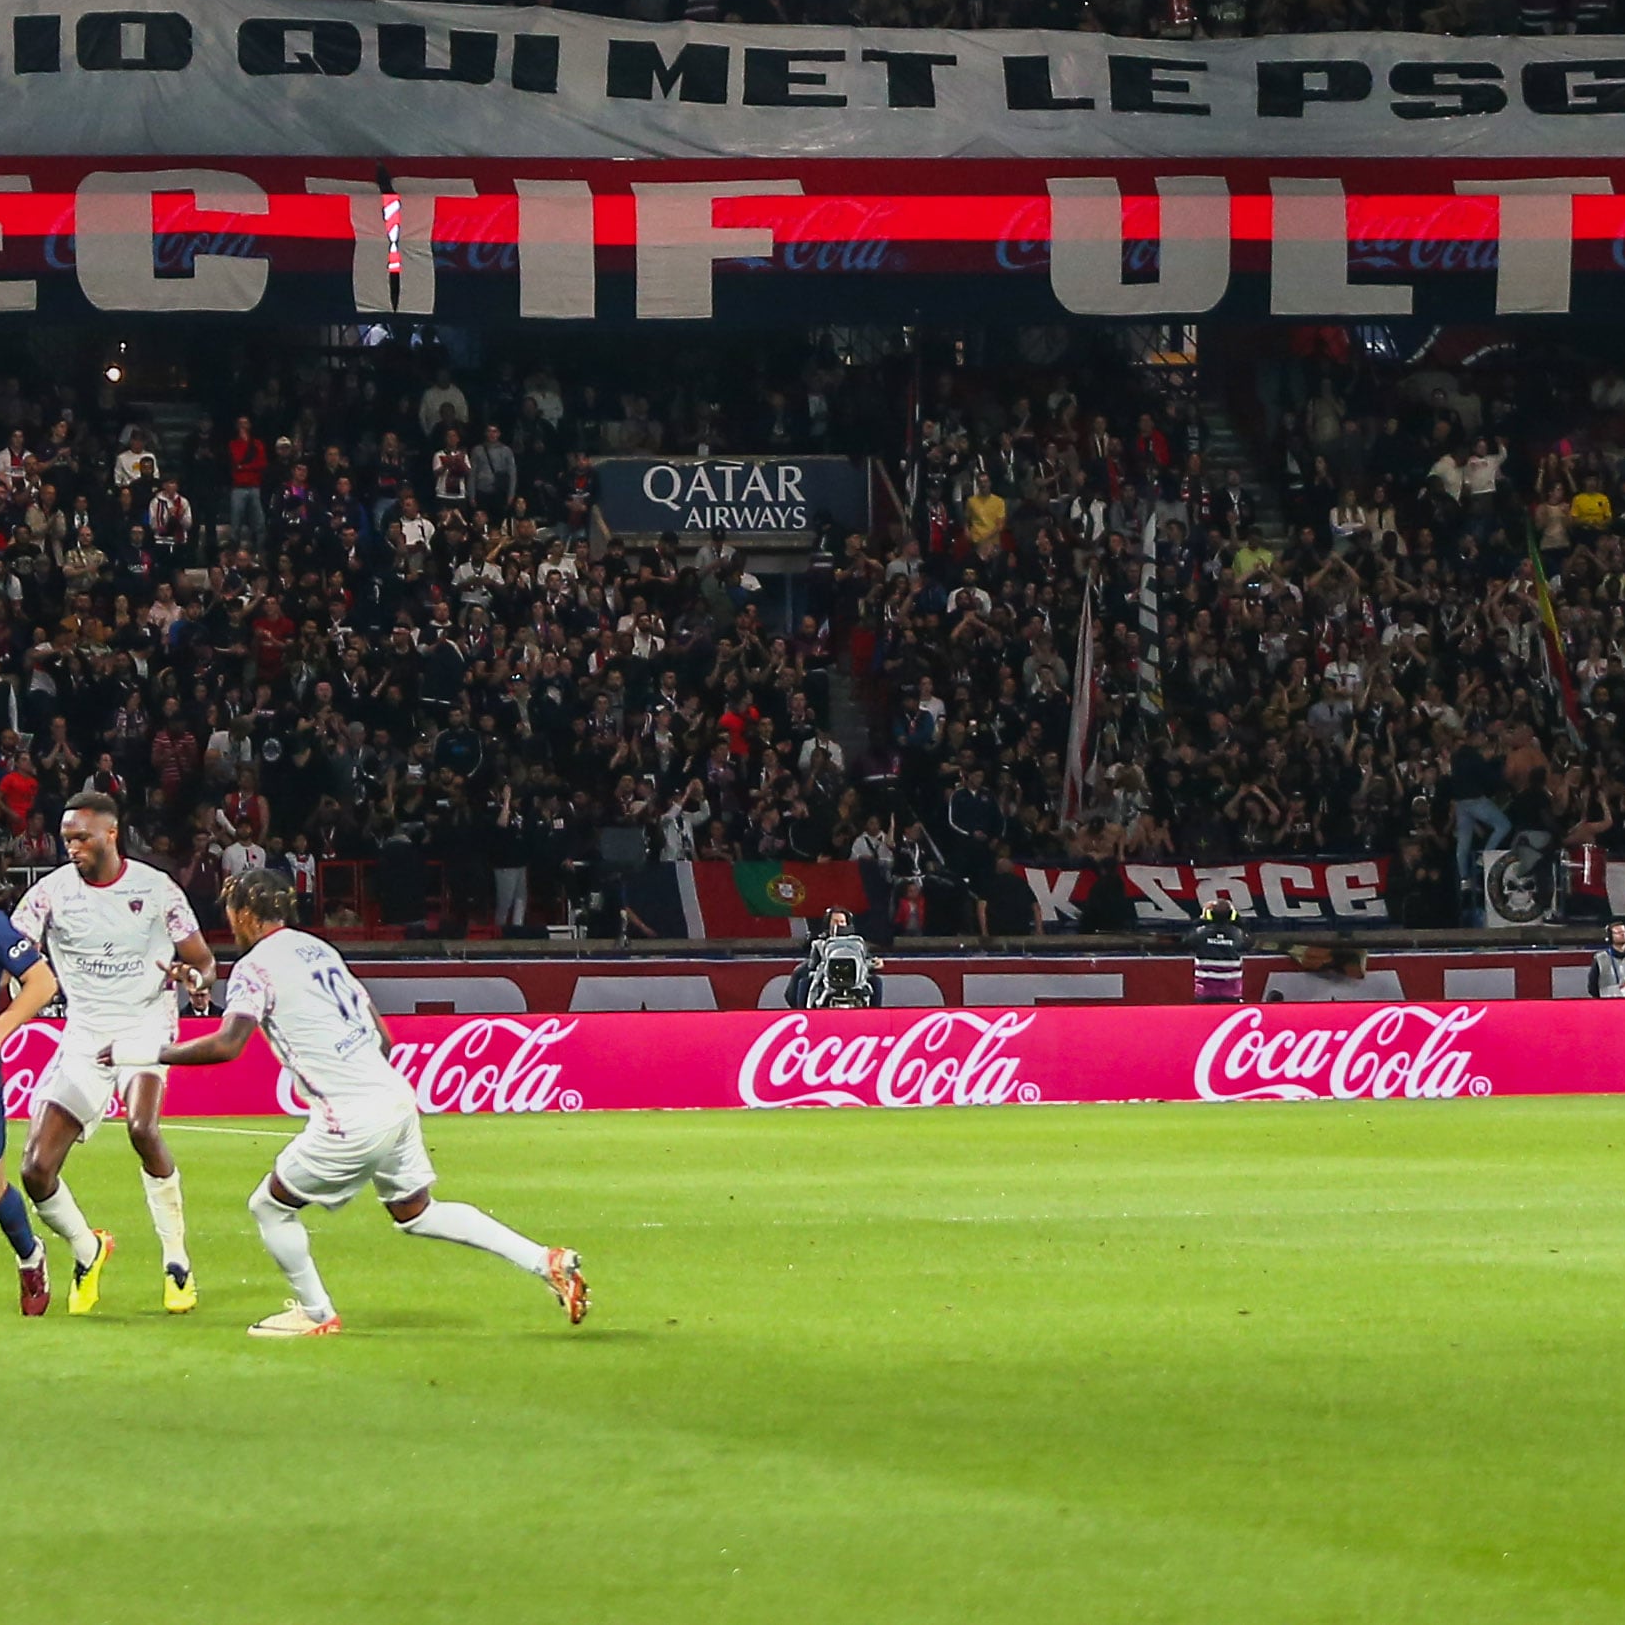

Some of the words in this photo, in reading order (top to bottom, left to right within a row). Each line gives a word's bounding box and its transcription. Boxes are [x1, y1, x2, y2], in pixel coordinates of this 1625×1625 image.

[237, 17, 560, 94] QUI
[606, 39, 957, 109] MET
[1002, 53, 1211, 116] LE
[642, 464, 807, 511] QATAR
[684, 506, 808, 529] AIRWAYS
[738, 1011, 1037, 1108] Coca-Cola
[1194, 1005, 1487, 1102] Coca-Cola
